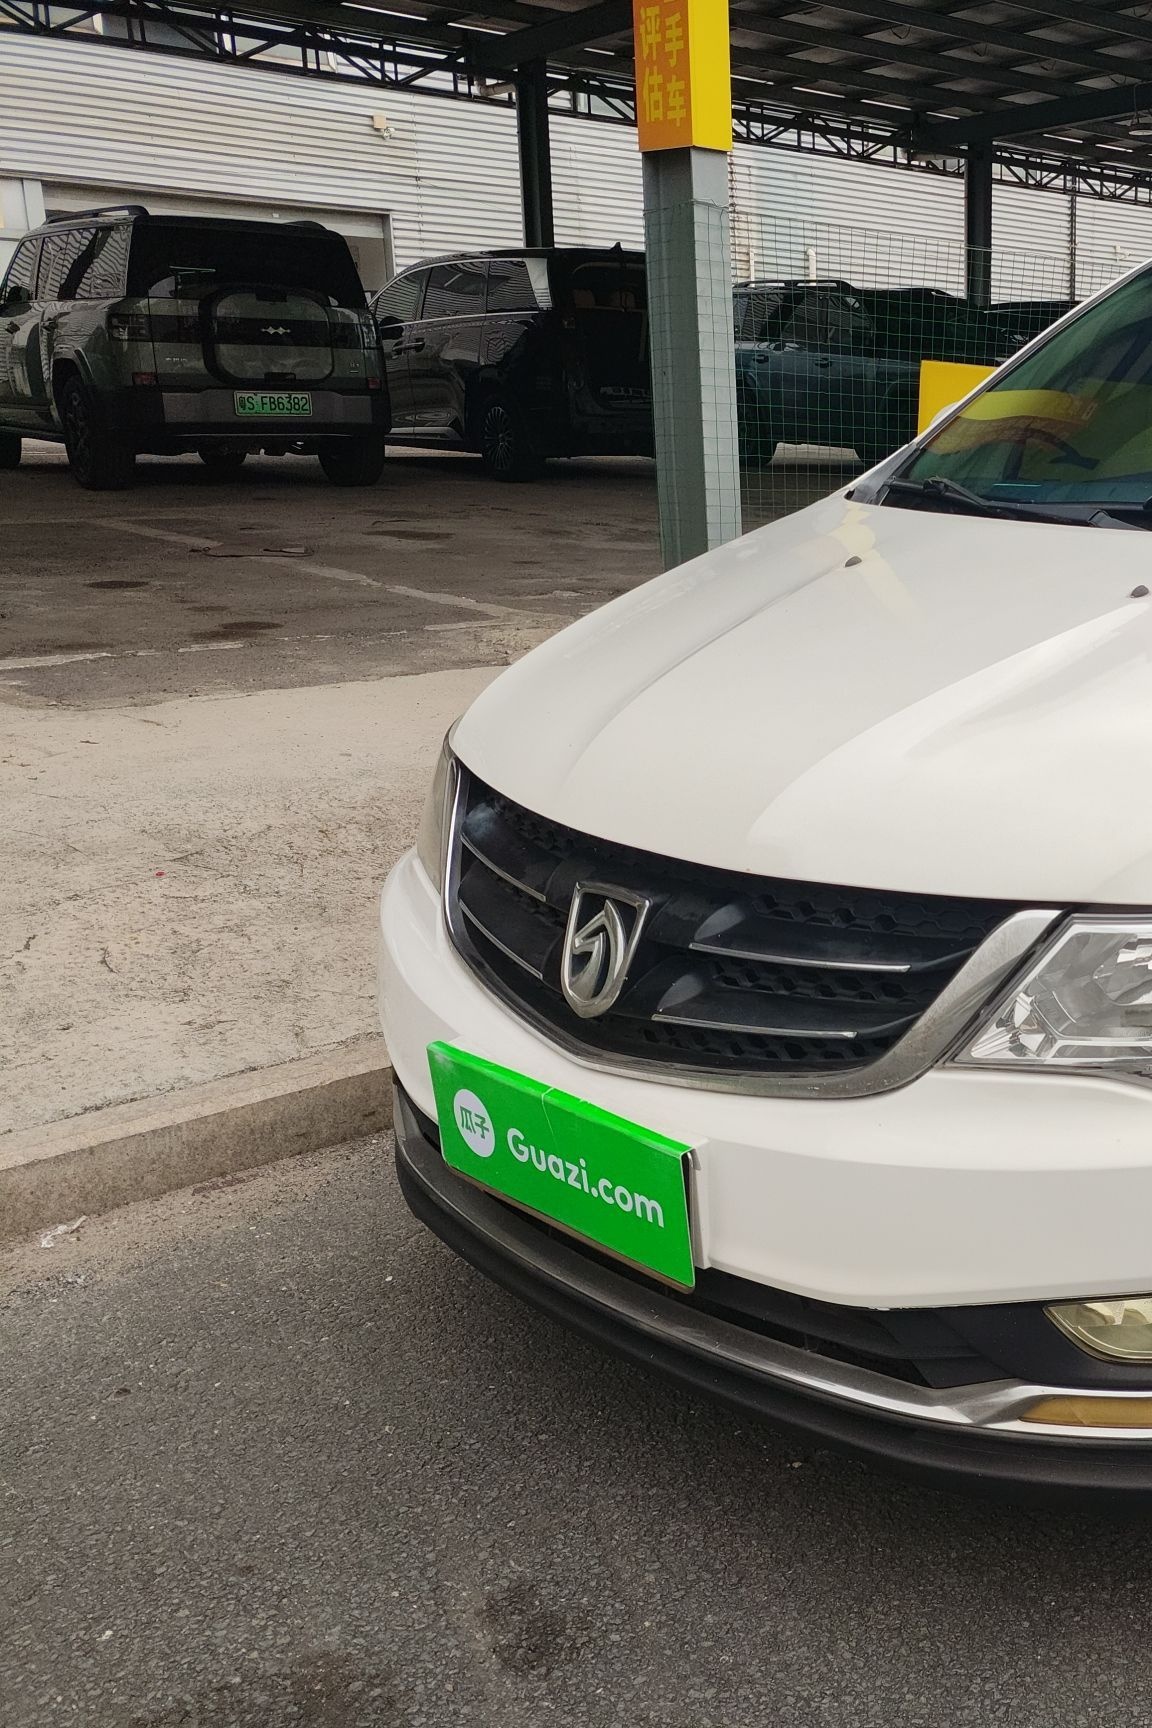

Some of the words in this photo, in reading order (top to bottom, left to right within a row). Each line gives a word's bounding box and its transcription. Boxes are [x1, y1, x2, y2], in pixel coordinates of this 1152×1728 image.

[639, 5, 663, 123] 评估
[664, 0, 687, 127] 手车
[261, 396, 309, 411] FB6382
[459, 1105, 490, 1140] 瓜子
[506, 1127, 665, 1229] Guazi.com
